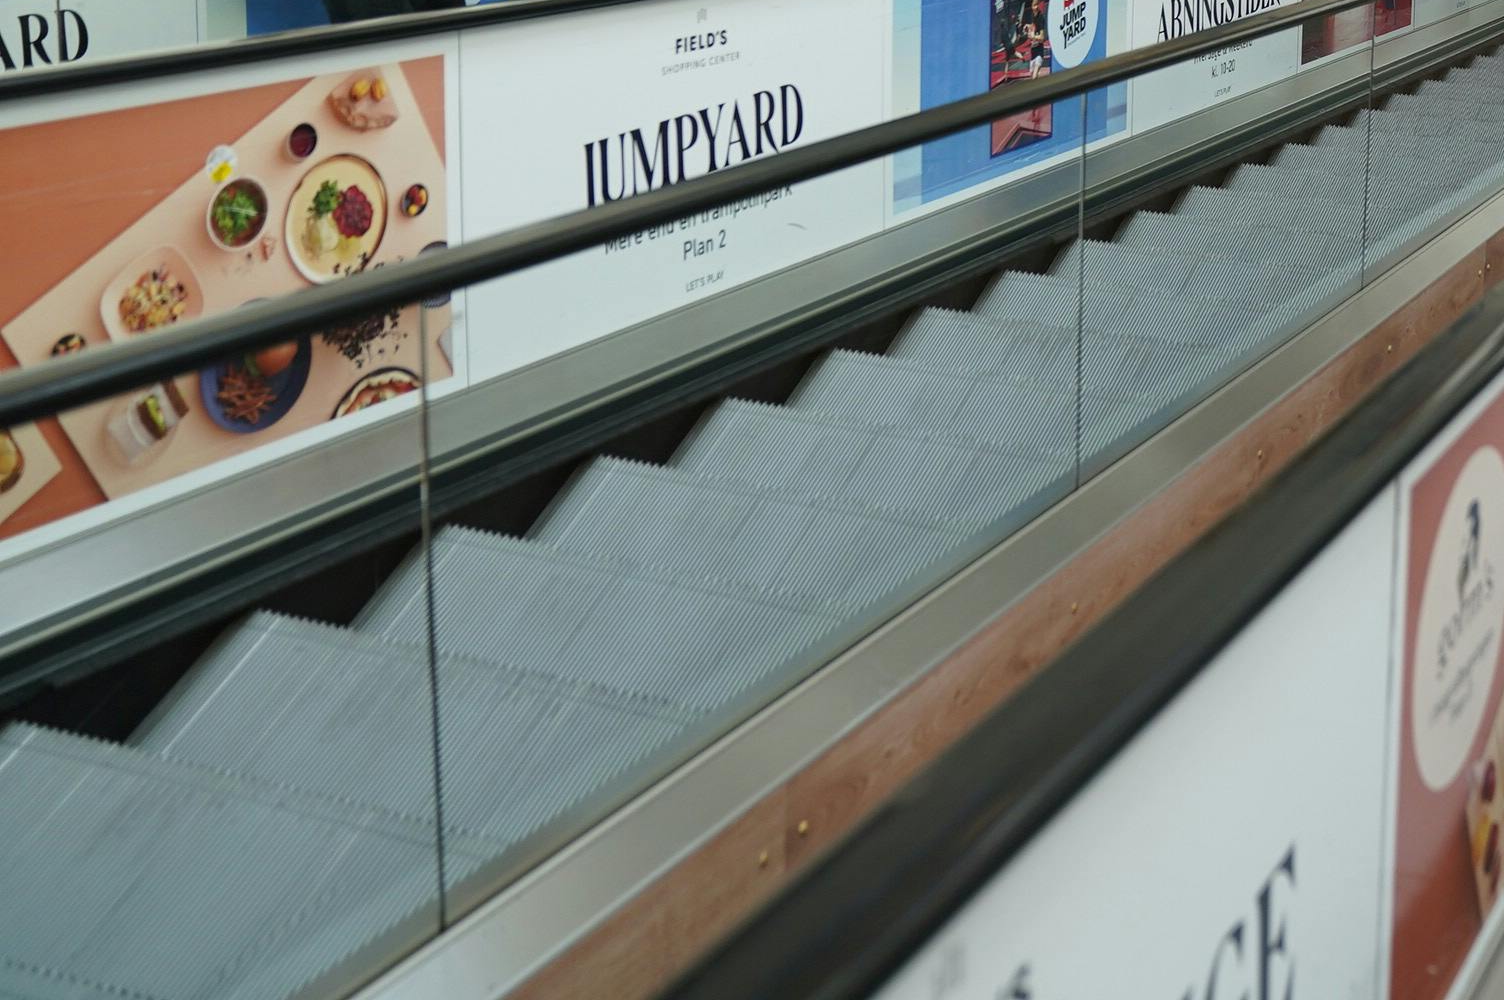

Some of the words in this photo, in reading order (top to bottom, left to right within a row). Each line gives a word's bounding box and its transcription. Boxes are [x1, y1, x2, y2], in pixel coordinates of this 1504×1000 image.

[1060, 1, 1087, 30] JUMP
[675, 29, 728, 55] FIELD'S
[1062, 17, 1087, 50] YARD
[661, 57, 706, 76] SHOPPING
[709, 51, 740, 66] CENTER
[583, 83, 804, 209] JUMPYARD
[683, 236, 714, 261] Plan
[718, 229, 727, 249] 2
